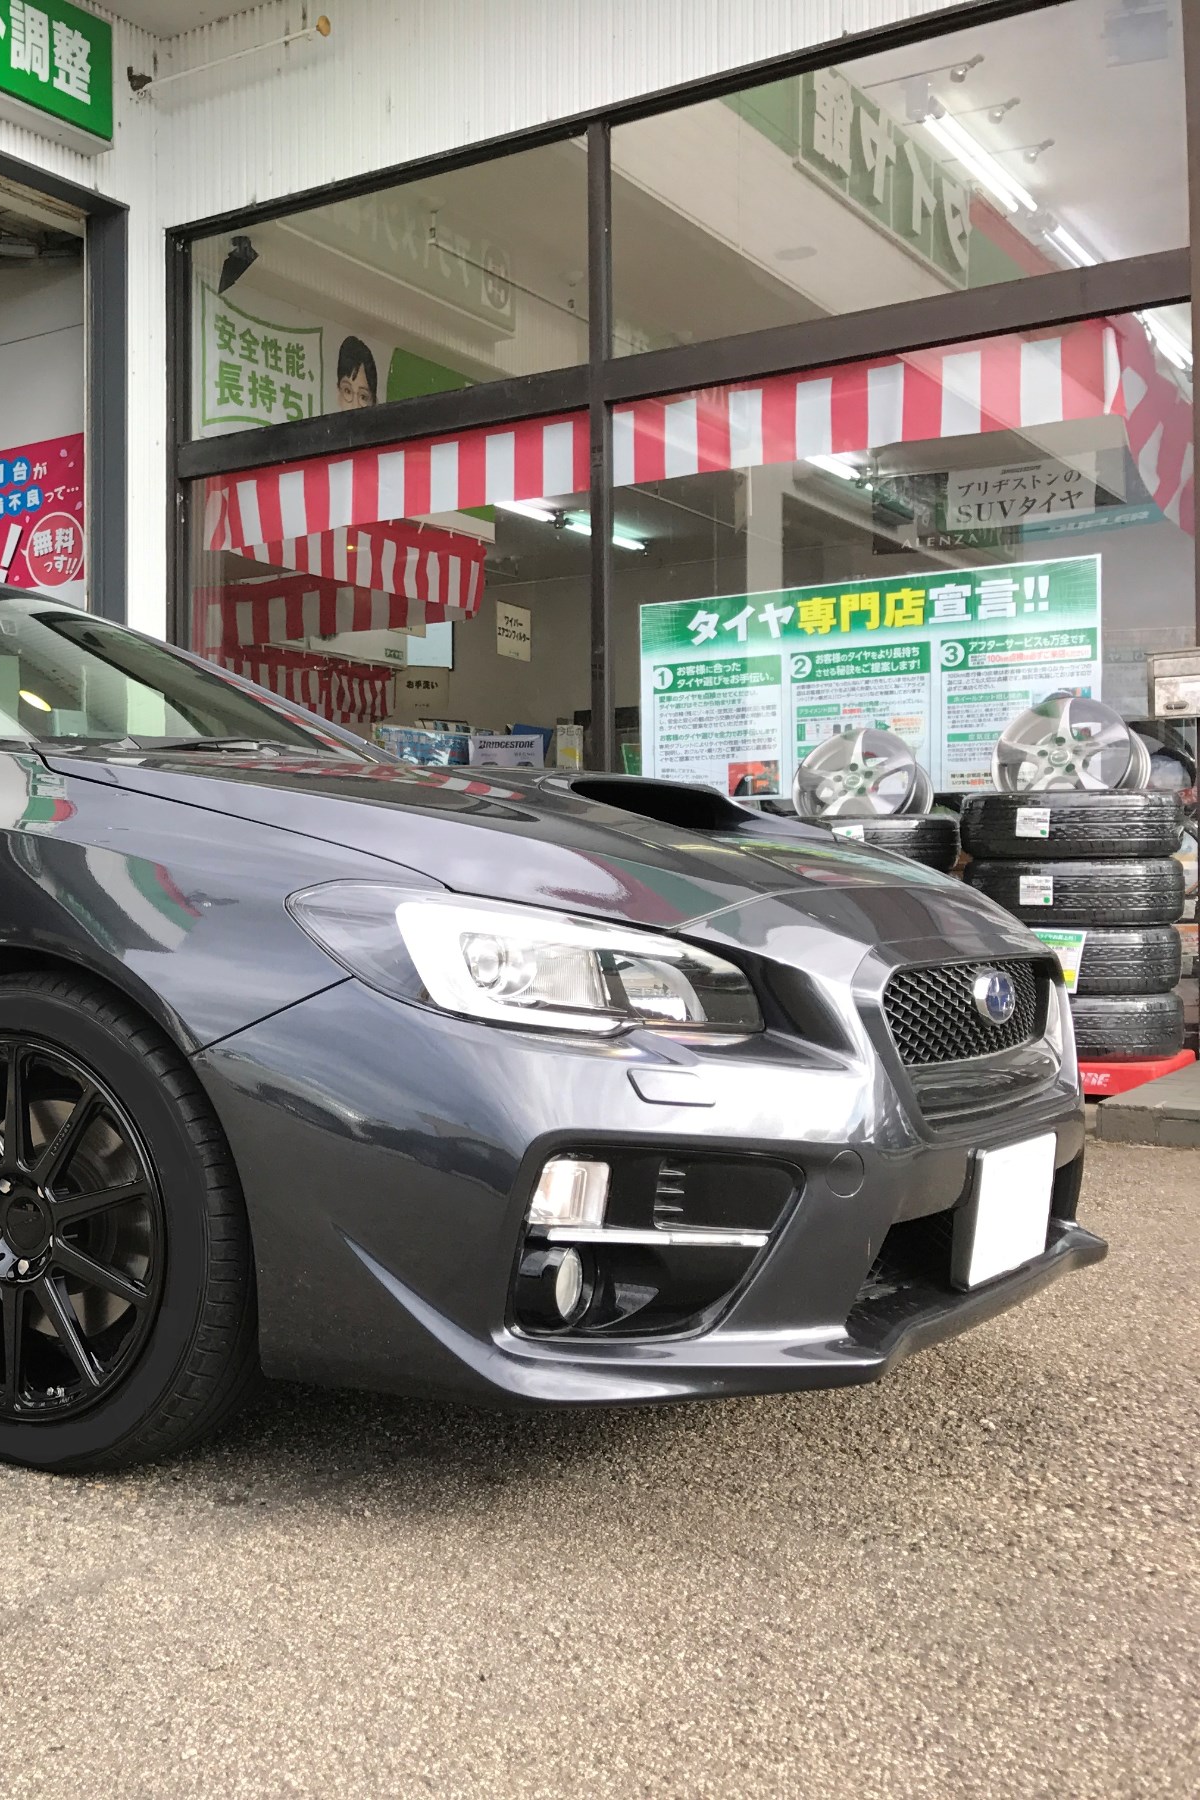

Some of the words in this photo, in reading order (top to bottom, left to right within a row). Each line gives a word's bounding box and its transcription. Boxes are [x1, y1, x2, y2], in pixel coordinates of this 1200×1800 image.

[214, 313, 315, 383] 安全性能、
[958, 470, 1082, 498] ブリヂストンの
[956, 489, 1084, 525] SUVタイヤ
[33, 527, 75, 557] 無料
[901, 532, 979, 550] ALENZA
[686, 575, 1050, 646] タイヤ専門店宣言!!
[968, 634, 1091, 652] アフターサービスも万全です。
[815, 646, 920, 665] お客様のタイヤをより長持ち
[944, 645, 959, 664] 3
[676, 662, 742, 677] お客様に合った
[794, 657, 808, 676] 2
[658, 670, 667, 687] 1
[676, 671, 775, 689] タイヤ選びをお手伝い。
[479, 740, 535, 749] BRIDGESTONE
